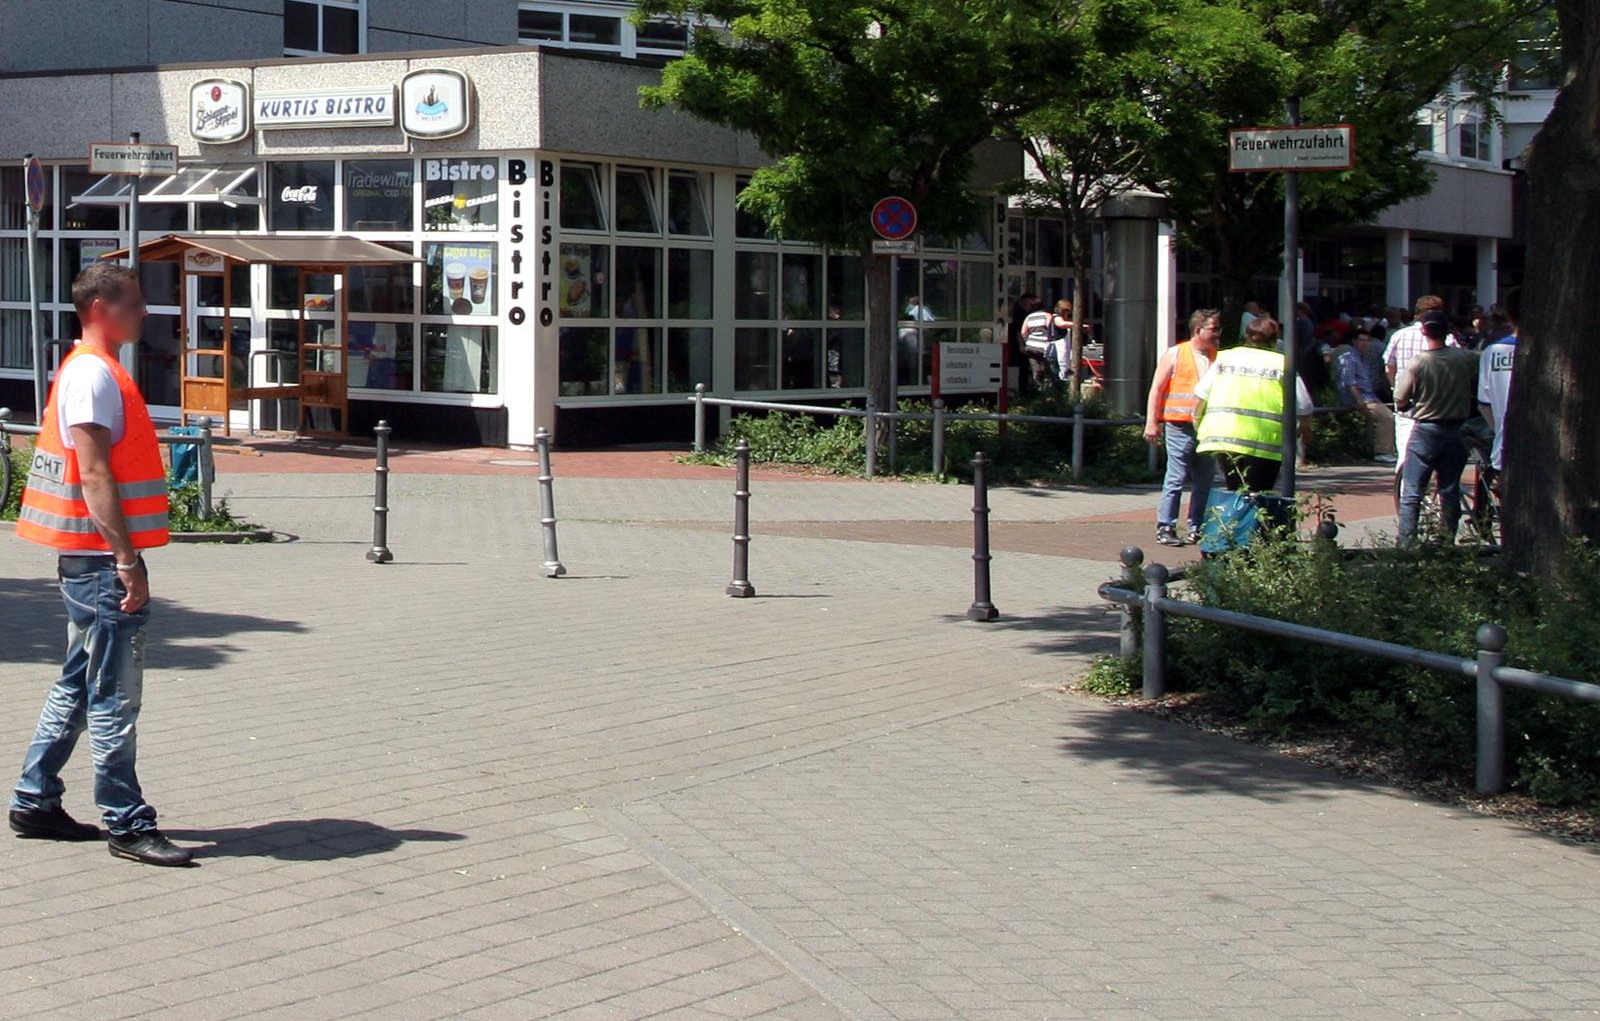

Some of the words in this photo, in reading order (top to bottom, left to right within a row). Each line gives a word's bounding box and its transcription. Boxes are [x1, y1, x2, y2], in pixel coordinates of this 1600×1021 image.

[260, 99, 319, 118] KURTIS
[325, 96, 386, 114] BISTRO
[1234, 134, 1345, 151] Feuerwehrzufahrt
[94, 148, 174, 161] Feuerwehrzufahrt
[426, 159, 496, 181] Bistro
[508, 159, 527, 326] Bistro
[540, 160, 554, 327] Bistro
